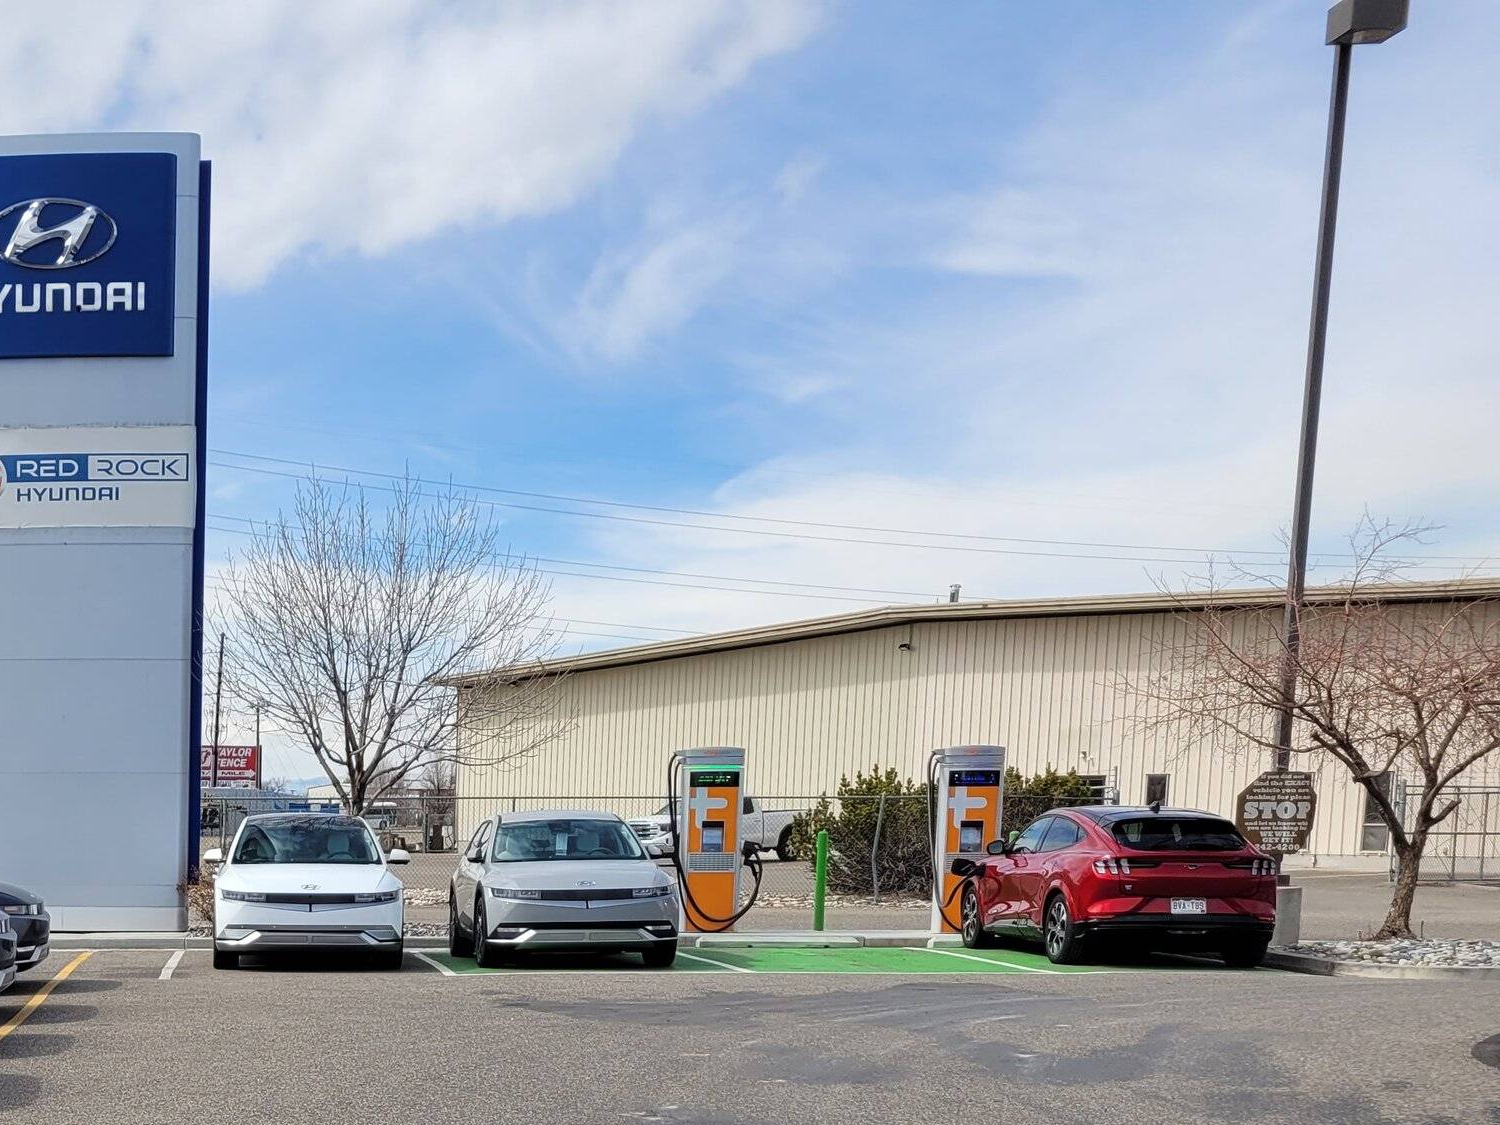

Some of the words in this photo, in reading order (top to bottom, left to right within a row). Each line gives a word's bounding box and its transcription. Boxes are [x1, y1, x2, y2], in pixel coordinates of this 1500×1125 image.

[16, 459, 79, 478] RED
[97, 459, 181, 476] ROCK
[16, 486, 120, 502] HYUNDAI
[1243, 801, 1311, 819] STOP
[1255, 843, 1300, 851] 242-4200
